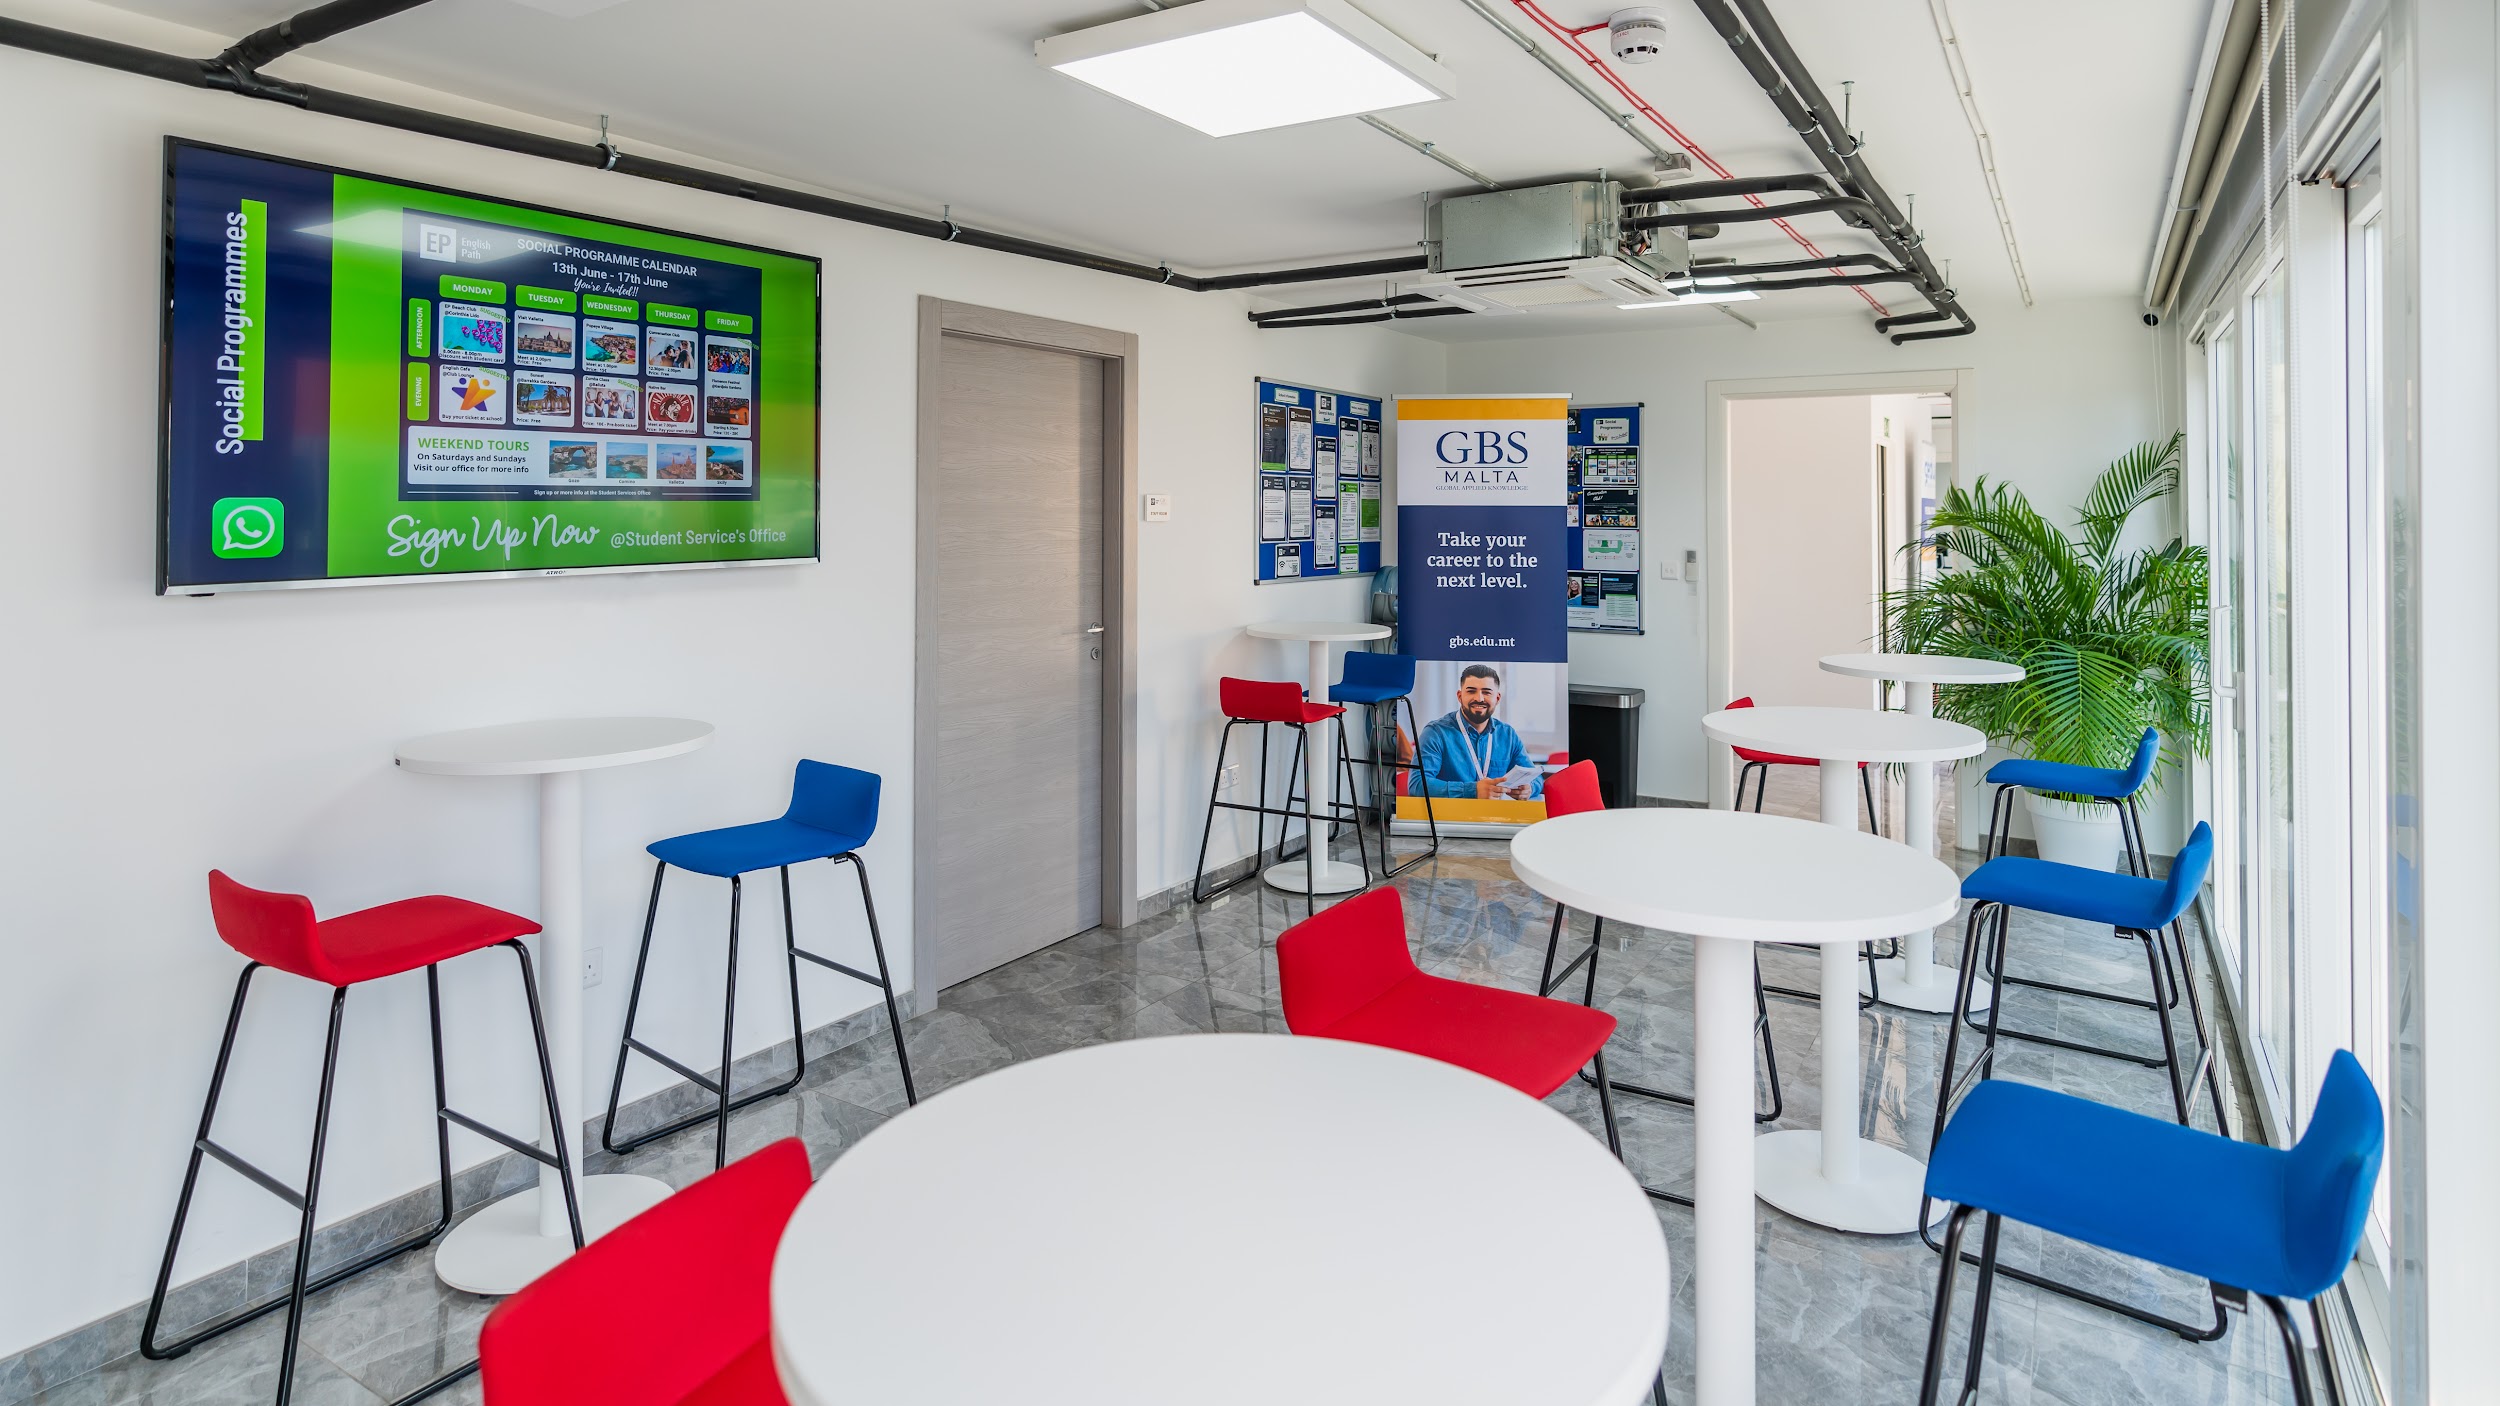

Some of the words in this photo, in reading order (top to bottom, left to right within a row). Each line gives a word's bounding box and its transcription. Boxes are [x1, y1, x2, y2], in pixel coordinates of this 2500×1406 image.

[426, 232, 451, 254] EP
[461, 237, 491, 251] English
[461, 249, 481, 260] Path
[517, 239, 562, 255] SOCIAL
[565, 246, 640, 267] PROGRAMME
[642, 258, 698, 277] CALENDAR
[552, 262, 578, 276] 13th
[580, 266, 607, 280] June
[617, 272, 641, 284] 17th
[643, 277, 669, 289] June
[217, 211, 253, 371] Programmes
[452, 284, 493, 295] MONDAY
[574, 277, 601, 292] You're
[603, 282, 639, 297] Invited!!
[528, 293, 565, 305] TUESDAY
[586, 301, 632, 313] WEDNESDAY
[655, 310, 691, 320] THURSDAY
[717, 318, 739, 327] FRIDAY
[216, 378, 245, 455] Social
[418, 438, 483, 450] WEEKEND
[488, 440, 530, 451] TOURS
[1436, 430, 1528, 465] GBS
[432, 453, 474, 462] Saturdays
[476, 454, 491, 462] and
[493, 455, 526, 463] Sundays
[413, 464, 433, 472] Visit
[452, 464, 475, 472] office
[477, 465, 489, 473] for
[513, 465, 529, 473] info
[1445, 470, 1519, 483] MALTA
[387, 513, 466, 568] Sign
[471, 515, 527, 561] Up
[531, 513, 600, 548] Now
[610, 530, 683, 548] @Student
[686, 529, 746, 546] Service's
[749, 528, 787, 543] Office
[1437, 531, 1481, 547] Take
[1485, 534, 1527, 551] your
[1427, 555, 1481, 567] career
[1486, 553, 1504, 568] to
[1509, 552, 1538, 568] the
[1436, 574, 1476, 588] next
[1480, 572, 1528, 588] level.
[1449, 635, 1516, 649] gbs.edu.mt
